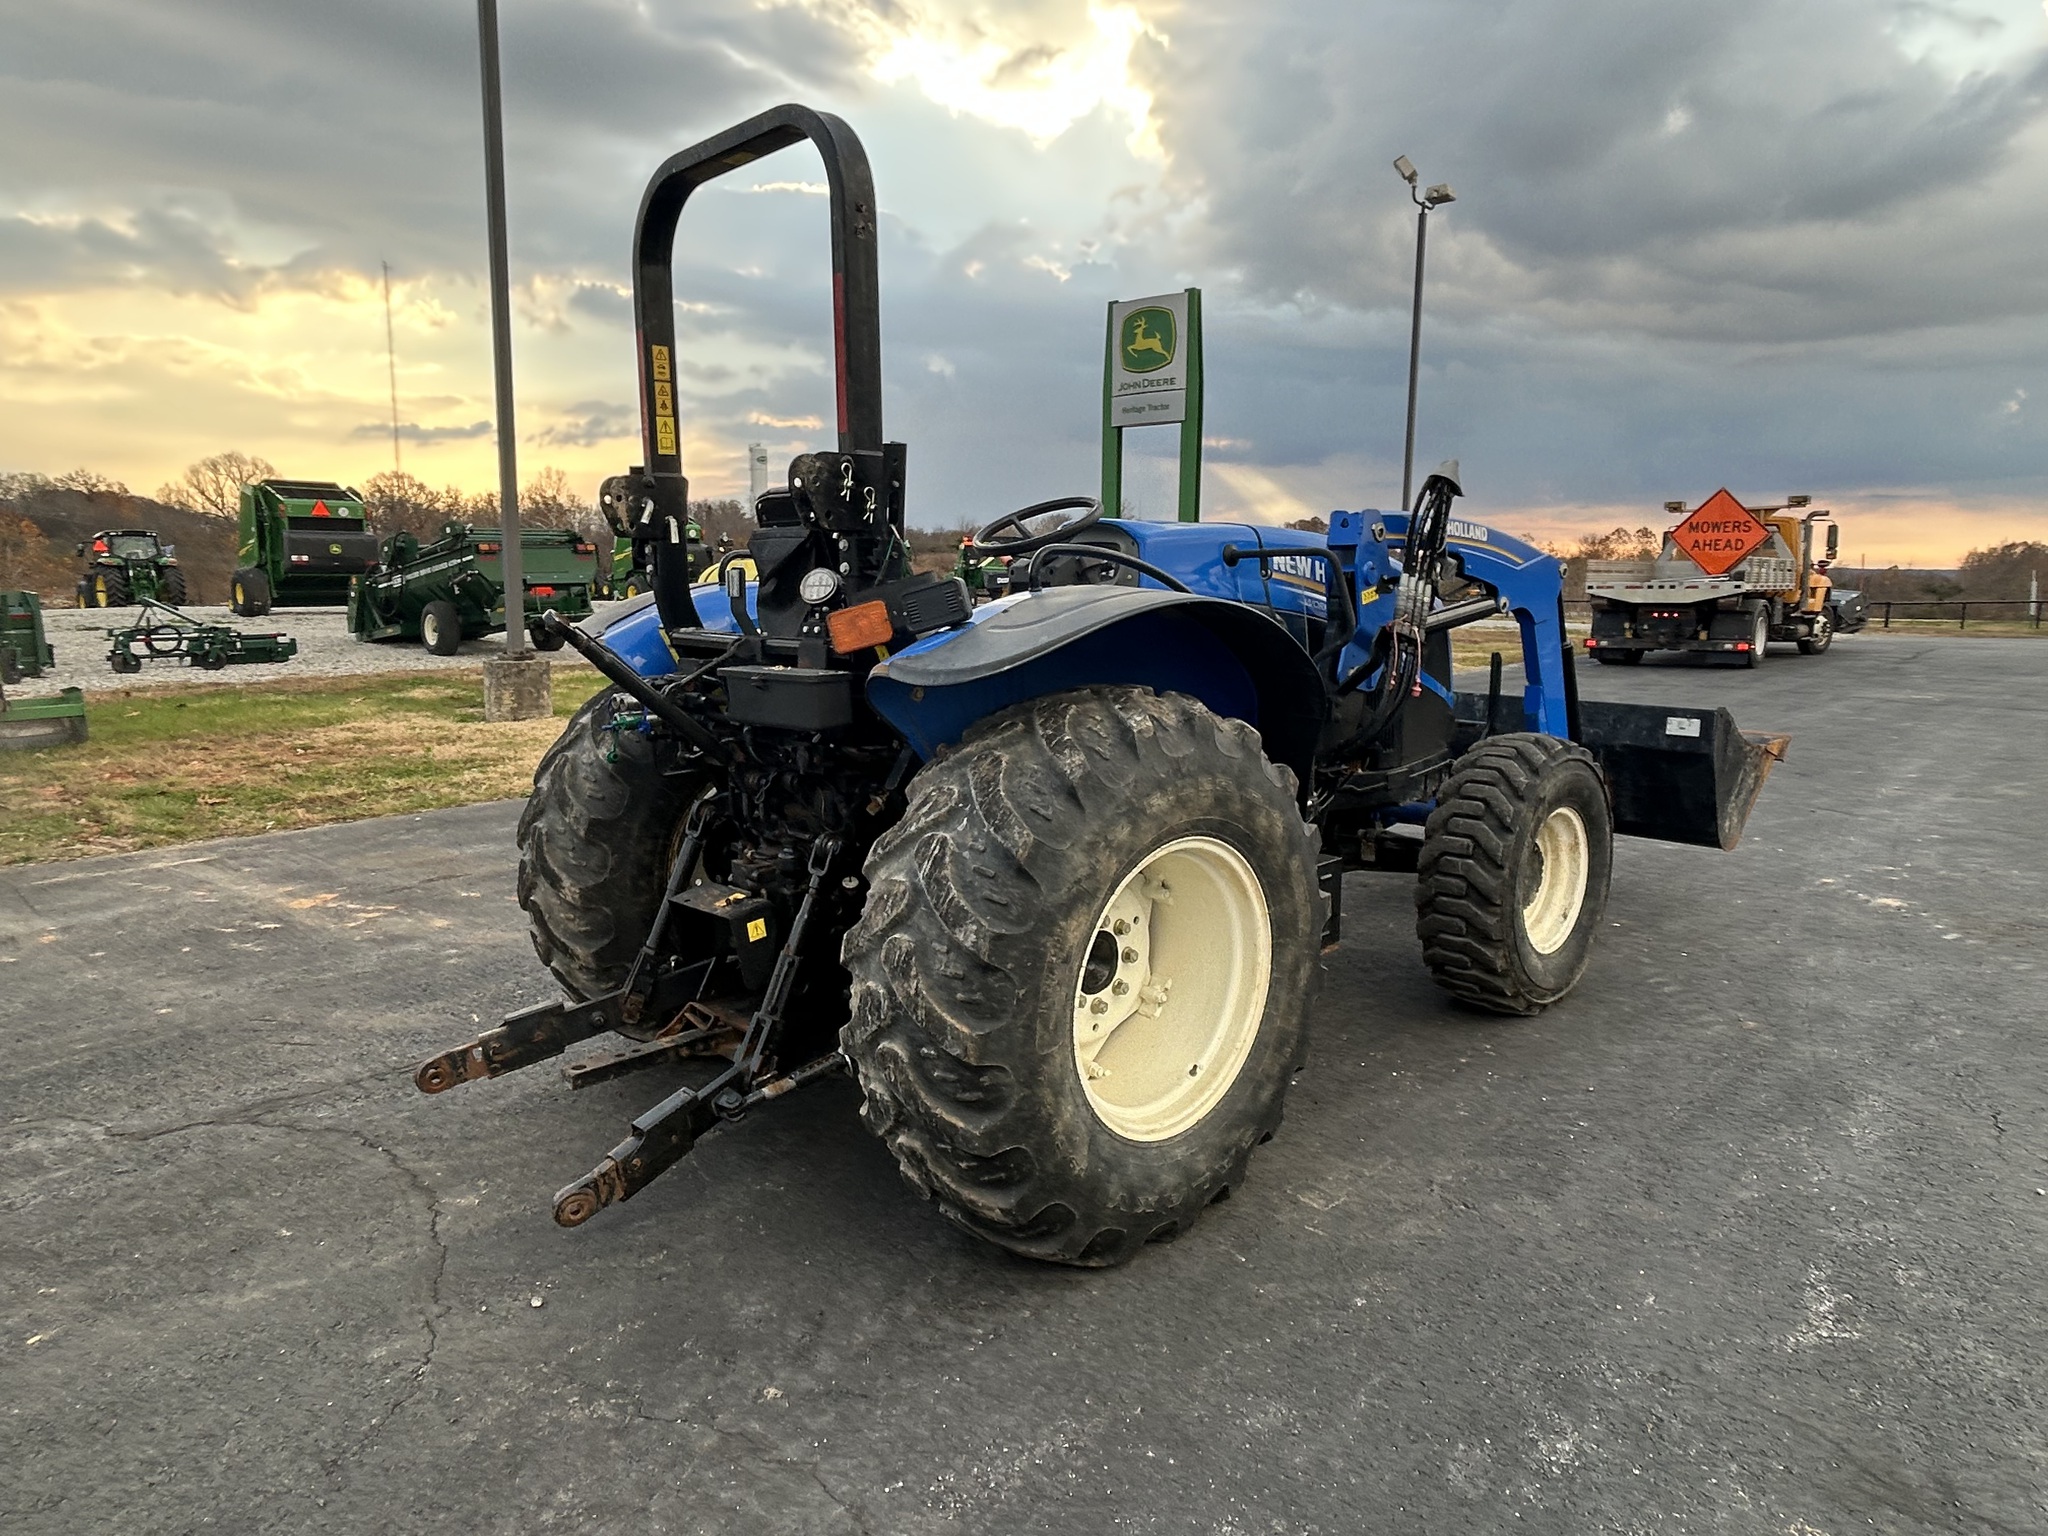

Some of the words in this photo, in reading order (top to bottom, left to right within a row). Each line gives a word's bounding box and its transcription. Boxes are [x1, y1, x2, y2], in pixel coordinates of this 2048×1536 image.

[1118, 381, 1141, 391] JOHN
[1142, 377, 1176, 388] DEERE
[1147, 403, 1170, 411] Tractor
[1446, 521, 1488, 542] HOLLAND
[1689, 520, 1752, 533] MOWERS
[1691, 538, 1744, 551] AHEAD
[1272, 555, 1312, 579] NEW
